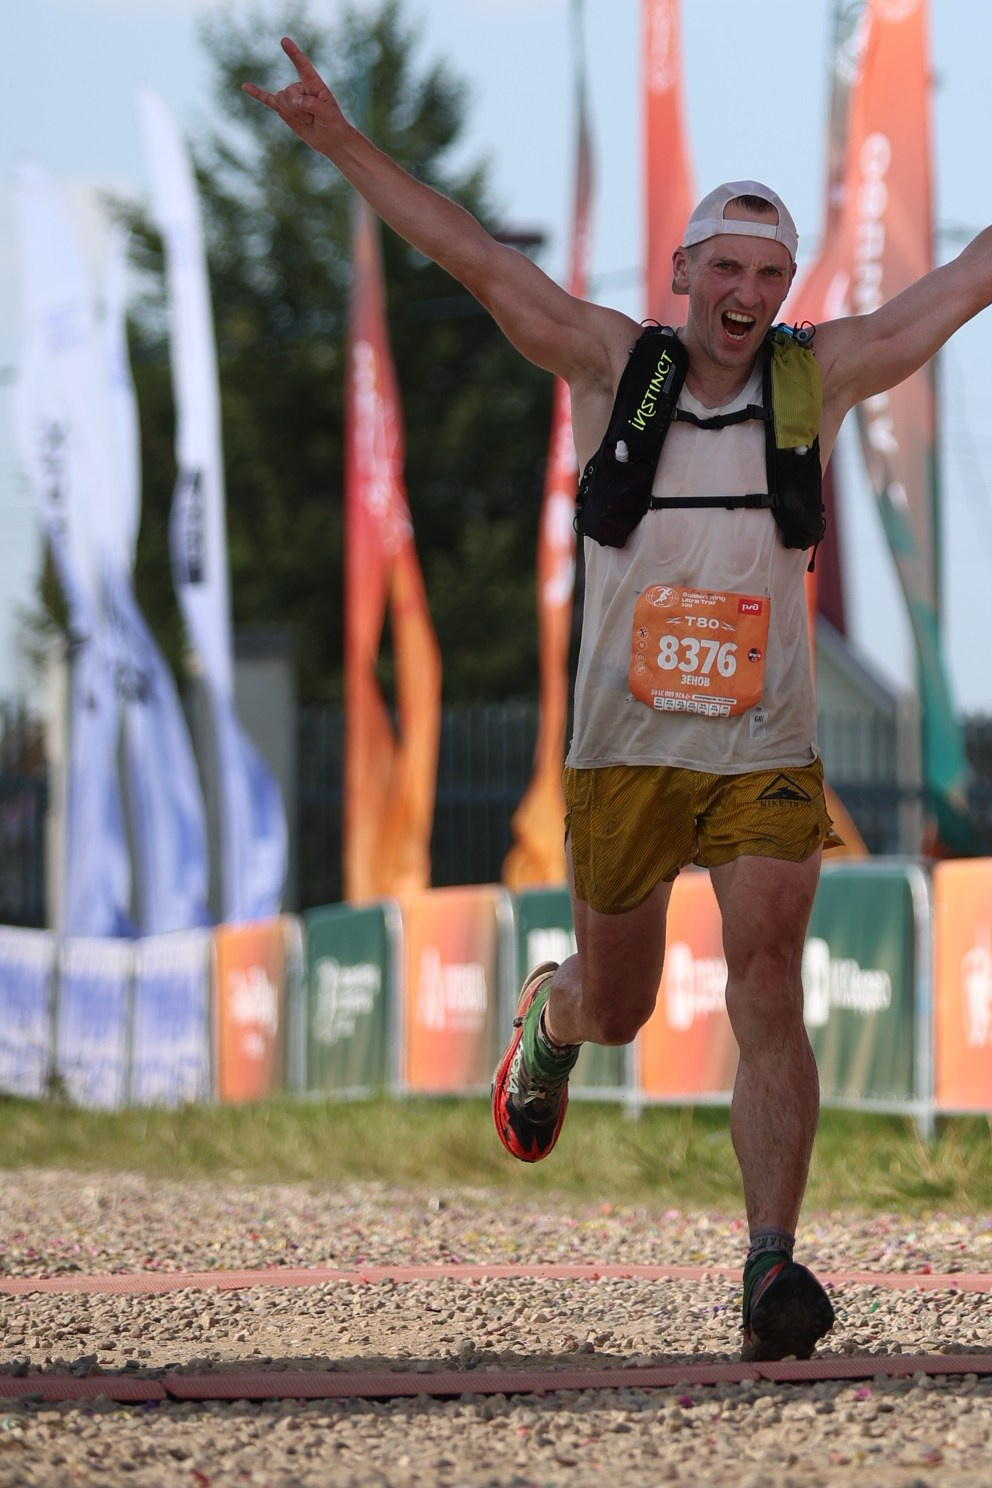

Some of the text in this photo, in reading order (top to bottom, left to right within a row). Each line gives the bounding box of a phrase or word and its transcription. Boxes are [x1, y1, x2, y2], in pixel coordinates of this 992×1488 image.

[684, 615, 720, 630] T80
[657, 635, 738, 678] 8376
[681, 674, 710, 687] ЗЕНОВ
